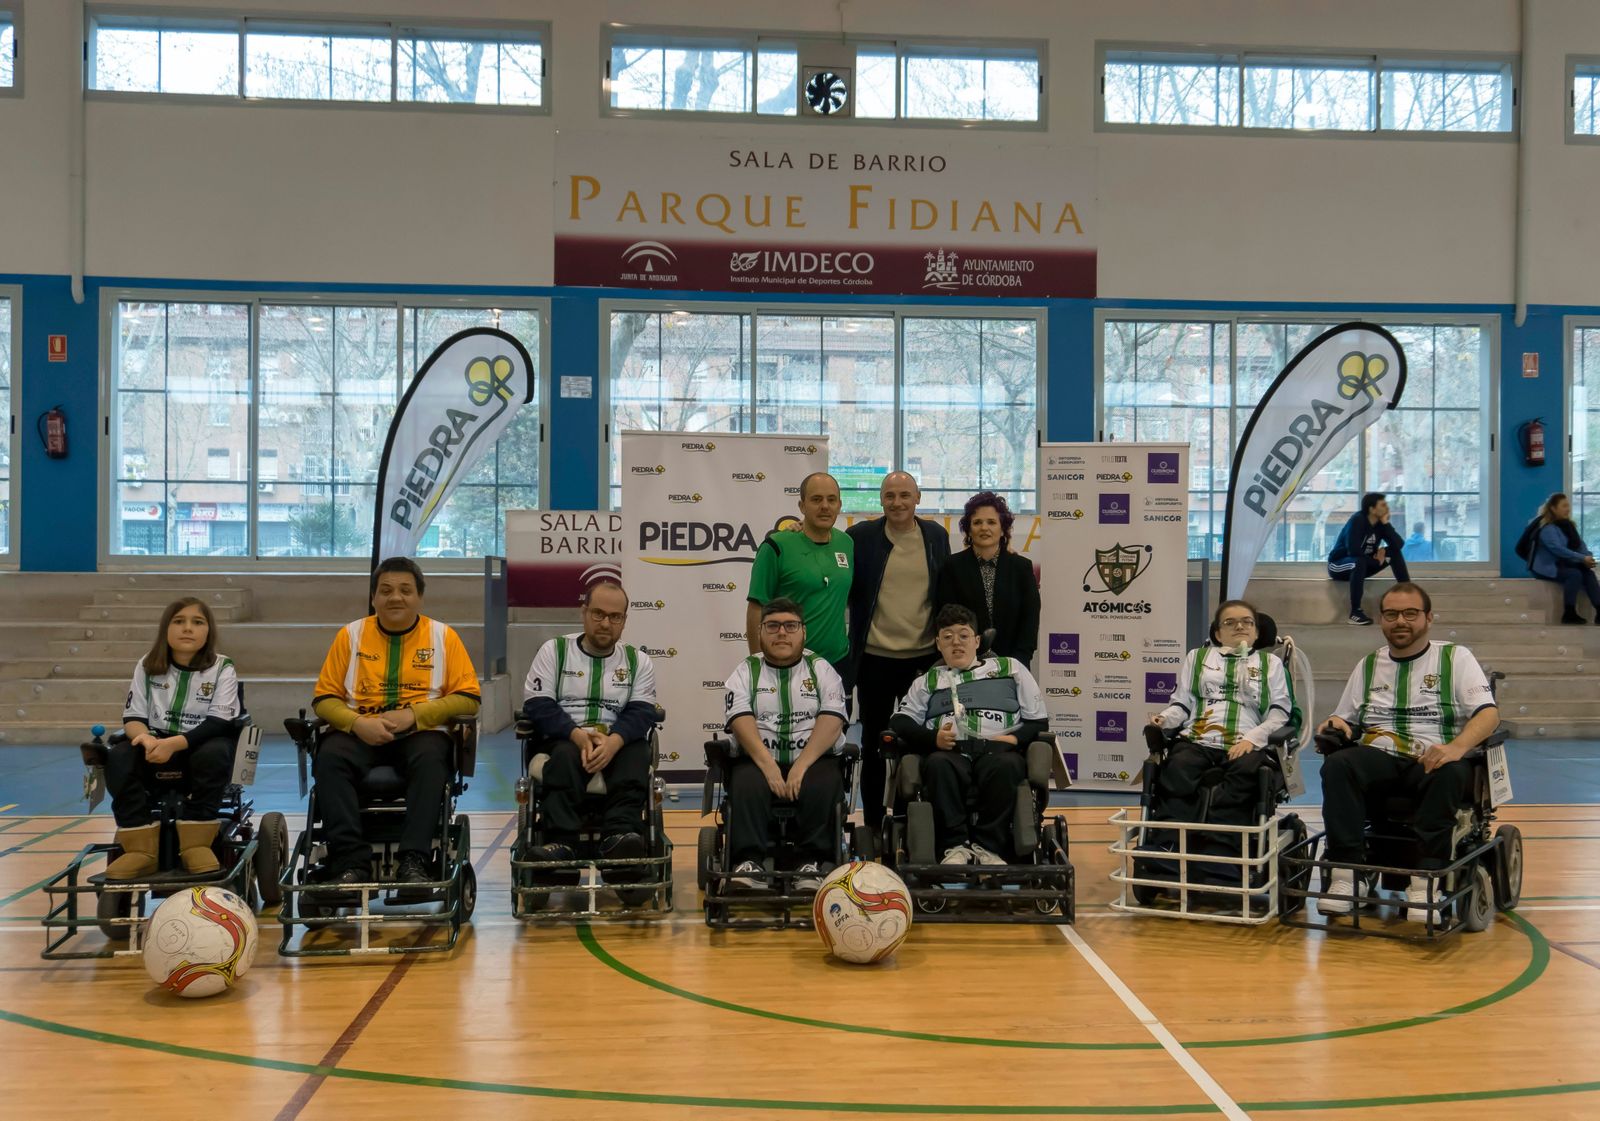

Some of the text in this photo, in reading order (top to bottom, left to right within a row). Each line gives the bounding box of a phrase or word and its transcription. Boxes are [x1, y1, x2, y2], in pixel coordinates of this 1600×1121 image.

[729, 150, 947, 173] SALA DE BARRIO
[568, 174, 1084, 234] PARQUE FIDIANA
[764, 251, 874, 274] IMDECO
[962, 260, 1034, 272] AYUNTAMIENTO
[761, 276, 796, 285] Municipal
[962, 272, 1022, 286] DE CÓRDOBA
[540, 514, 622, 532] SALA D
[540, 536, 622, 554] BARRI
[1083, 600, 1152, 613] ATÓMICOS
[533, 678, 542, 691] 3
[763, 738, 810, 750] ANICO
